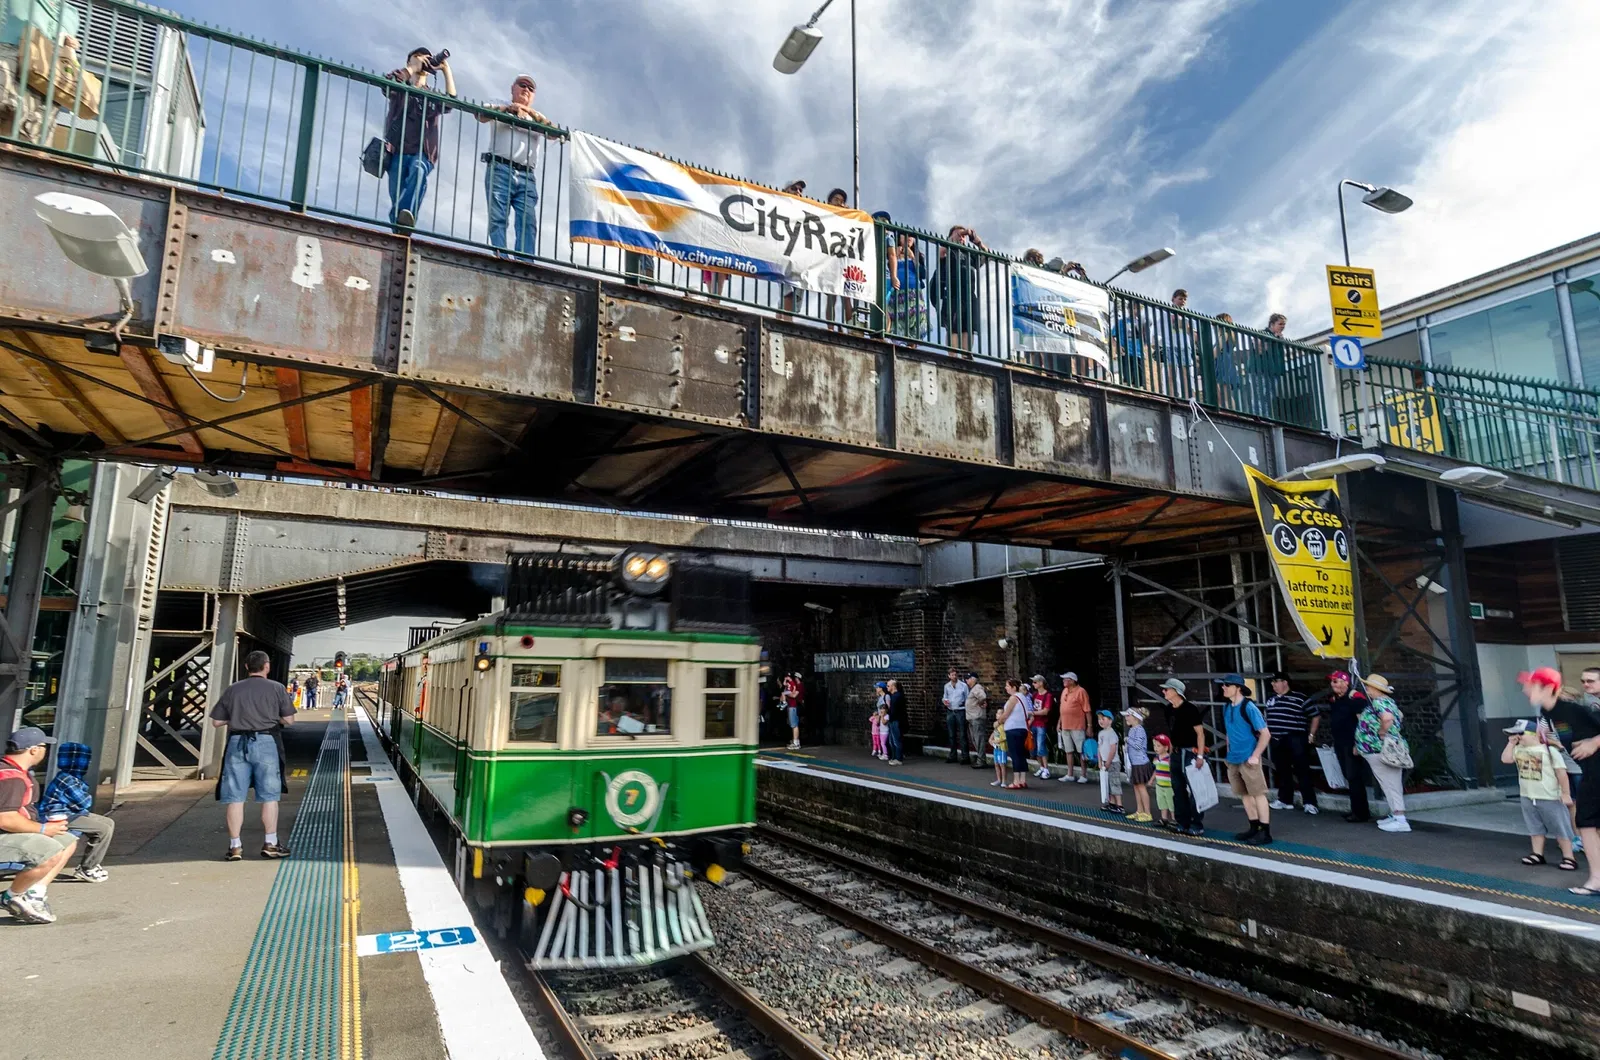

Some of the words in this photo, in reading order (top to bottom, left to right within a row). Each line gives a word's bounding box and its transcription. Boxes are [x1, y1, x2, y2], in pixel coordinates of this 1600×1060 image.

[719, 194, 866, 261] CityRail
[654, 240, 758, 275] www.cityrail.info
[843, 281, 865, 293] NSW
[1333, 273, 1372, 287] Stairs
[1037, 302, 1065, 315] Travel
[1042, 313, 1061, 322] with
[1045, 320, 1081, 335] CityRail
[1343, 343, 1352, 361] 1
[1271, 504, 1343, 528] Access
[1316, 570, 1329, 581] To
[1287, 580, 1329, 594] latforms
[1294, 596, 1308, 607] nd
[1310, 597, 1339, 609] station
[1341, 599, 1353, 611] exit
[831, 654, 890, 669] MAITLAND
[625, 789, 640, 807] 7
